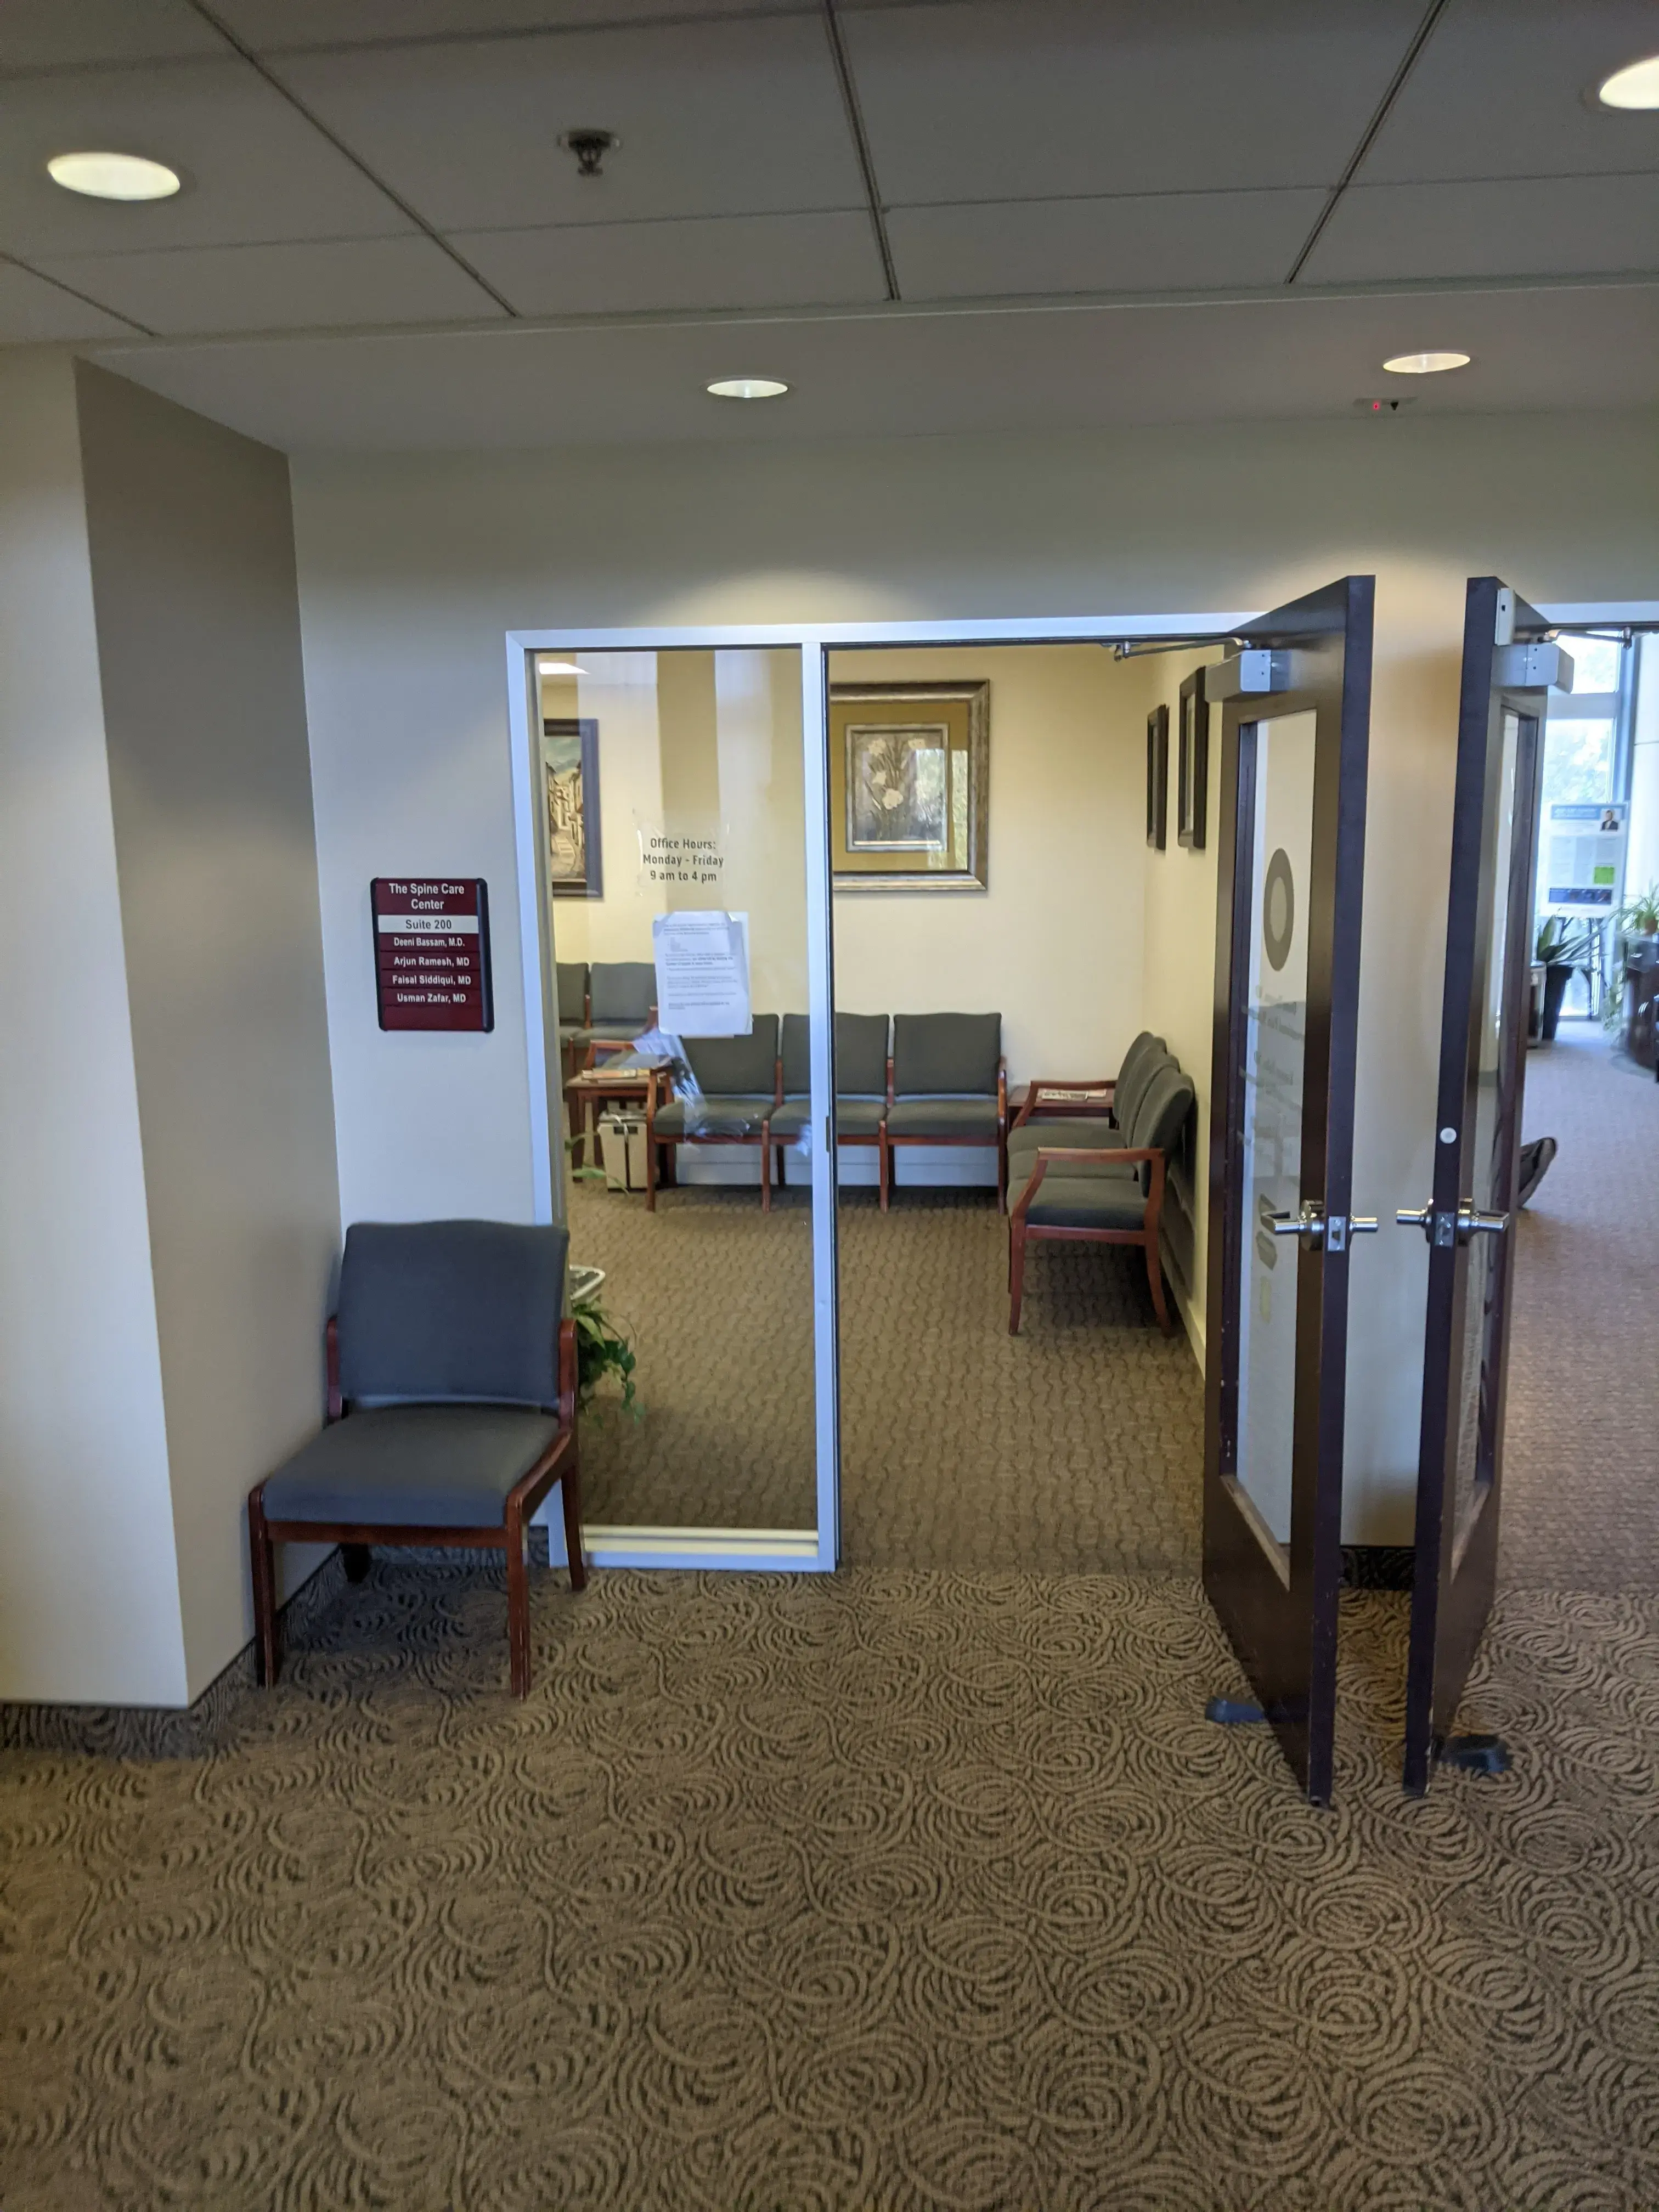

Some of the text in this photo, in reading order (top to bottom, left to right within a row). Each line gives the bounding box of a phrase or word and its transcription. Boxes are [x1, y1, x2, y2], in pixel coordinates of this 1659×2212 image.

[651, 838, 716, 849] Office Hours:
[643, 854, 682, 867] Monday
[693, 855, 724, 868] Friday
[651, 870, 716, 884] 9 am to 4 pm
[389, 883, 464, 896] The Spine Care
[411, 899, 444, 909] Center
[406, 919, 452, 929] Suite 200
[394, 938, 465, 947] Deeni Bassam, M.D.
[394, 957, 469, 967] Arjun Ramesh, MD
[393, 975, 471, 986] Faisal Siddiqui, MD
[397, 993, 465, 1004] Usman Zafar, MD
